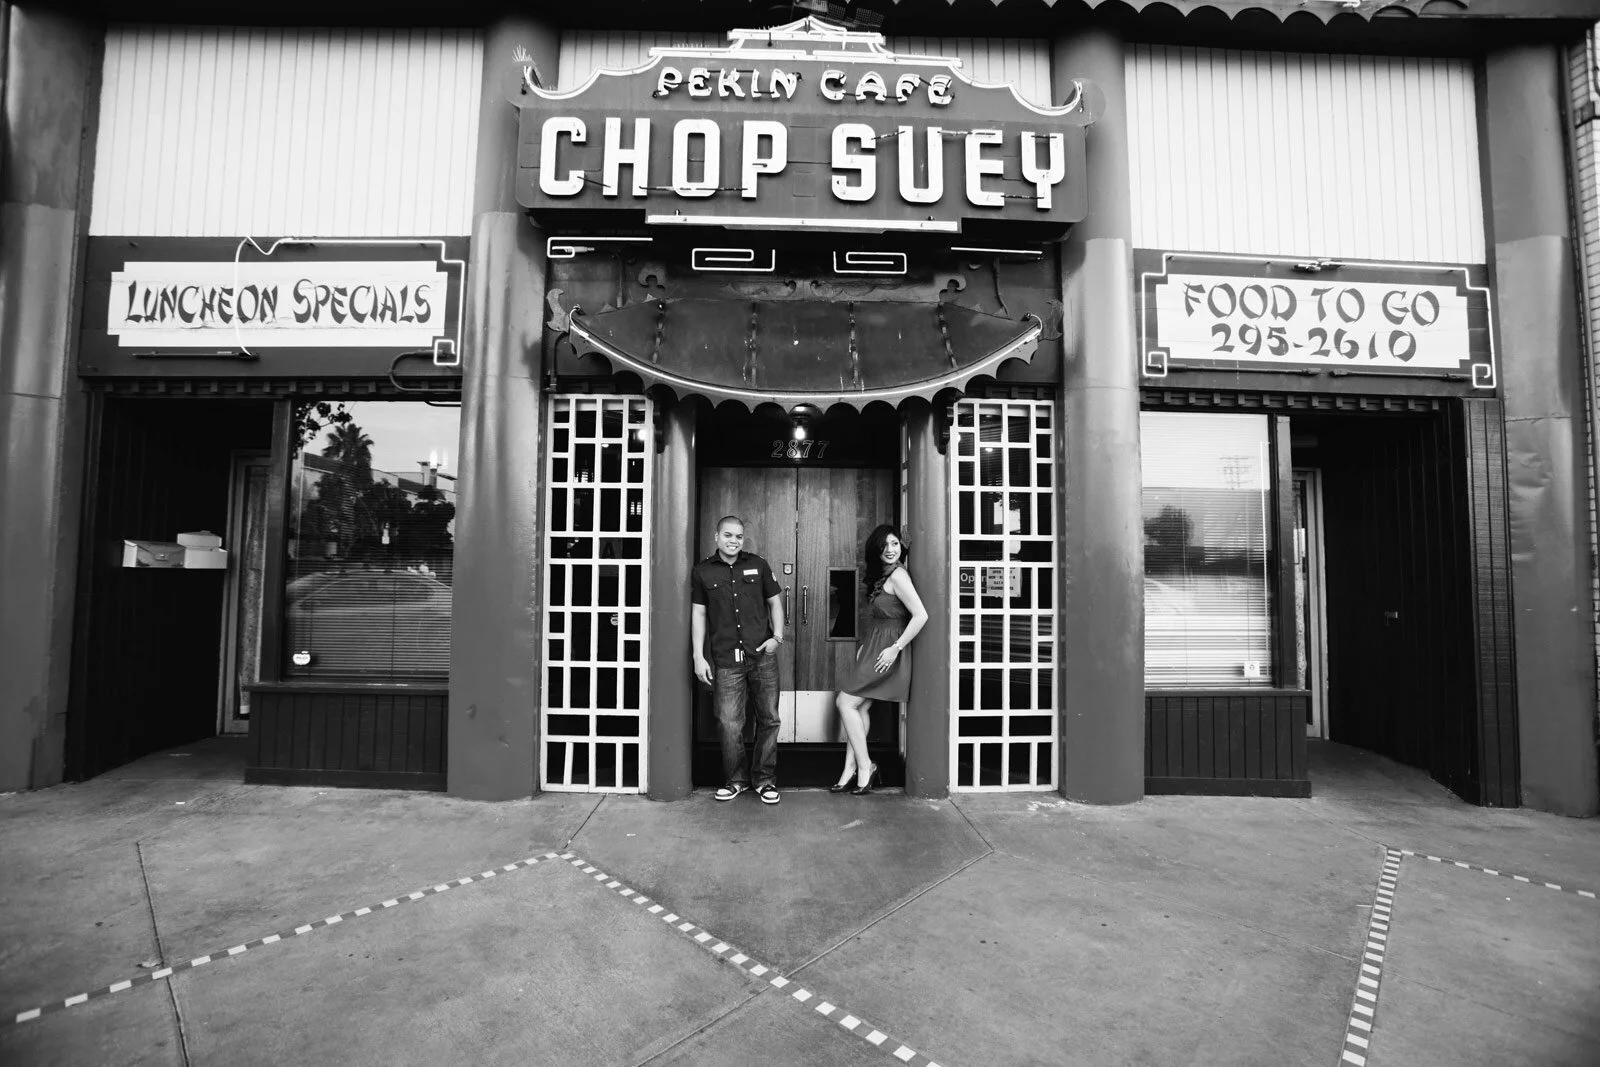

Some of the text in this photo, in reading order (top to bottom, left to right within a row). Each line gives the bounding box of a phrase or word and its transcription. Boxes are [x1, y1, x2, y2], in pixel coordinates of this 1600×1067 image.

[658, 67, 952, 104] PEKIN CAFE
[540, 117, 1064, 208] CHOP SUEY
[125, 279, 431, 324] LUNCHEON SPECIALS
[1184, 282, 1440, 326] FOOD TO GO
[1211, 323, 1417, 362] 295-2610
[771, 439, 829, 458] 2877
[960, 572, 987, 584] Opn
